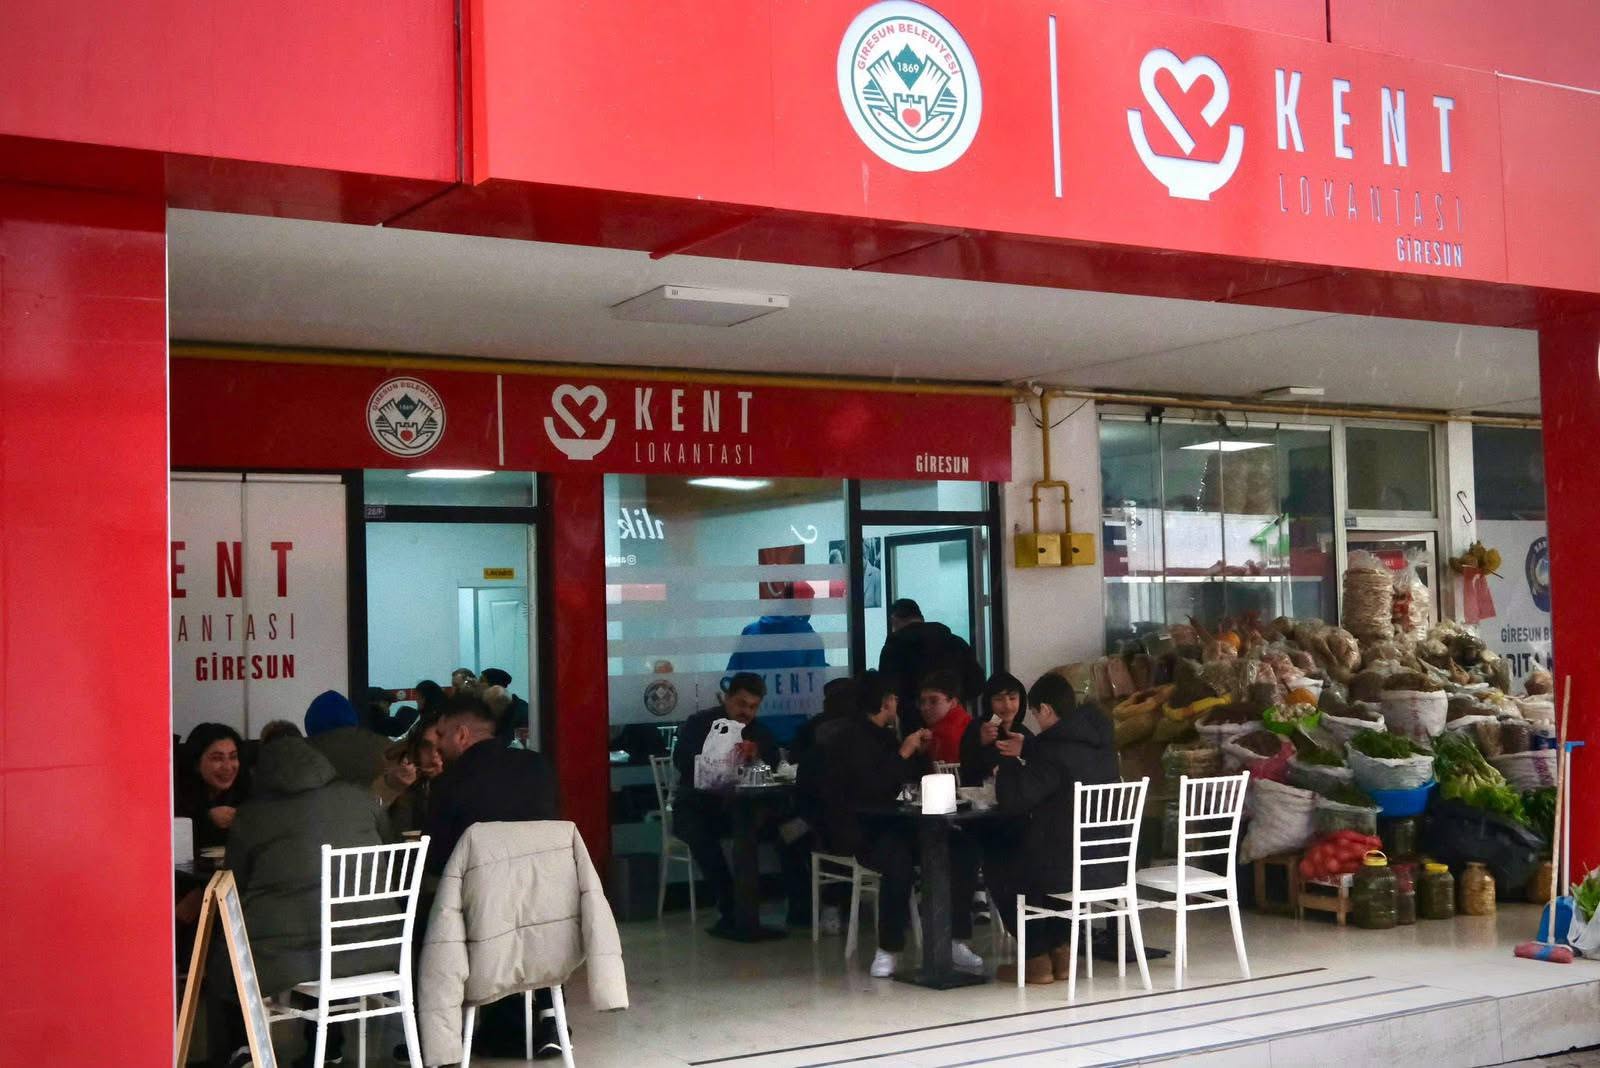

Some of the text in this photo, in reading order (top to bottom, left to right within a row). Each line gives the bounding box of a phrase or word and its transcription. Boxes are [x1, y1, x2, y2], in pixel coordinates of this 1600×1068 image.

[857, 23, 961, 76] GİRESUN BELEDİYESİ
[897, 62, 920, 74] 1869
[1275, 68, 1456, 173] KENT
[1279, 173, 1463, 233] LOKANTASI
[1396, 234, 1463, 267] GİRESUN
[635, 387, 753, 433] KENT
[635, 441, 753, 464] LOKANTASI
[916, 452, 969, 474] GİRESUN
[178, 612, 294, 641] ANTASI
[1501, 624, 1542, 642] GİRESUN
[195, 652, 295, 681] GİRESUN
